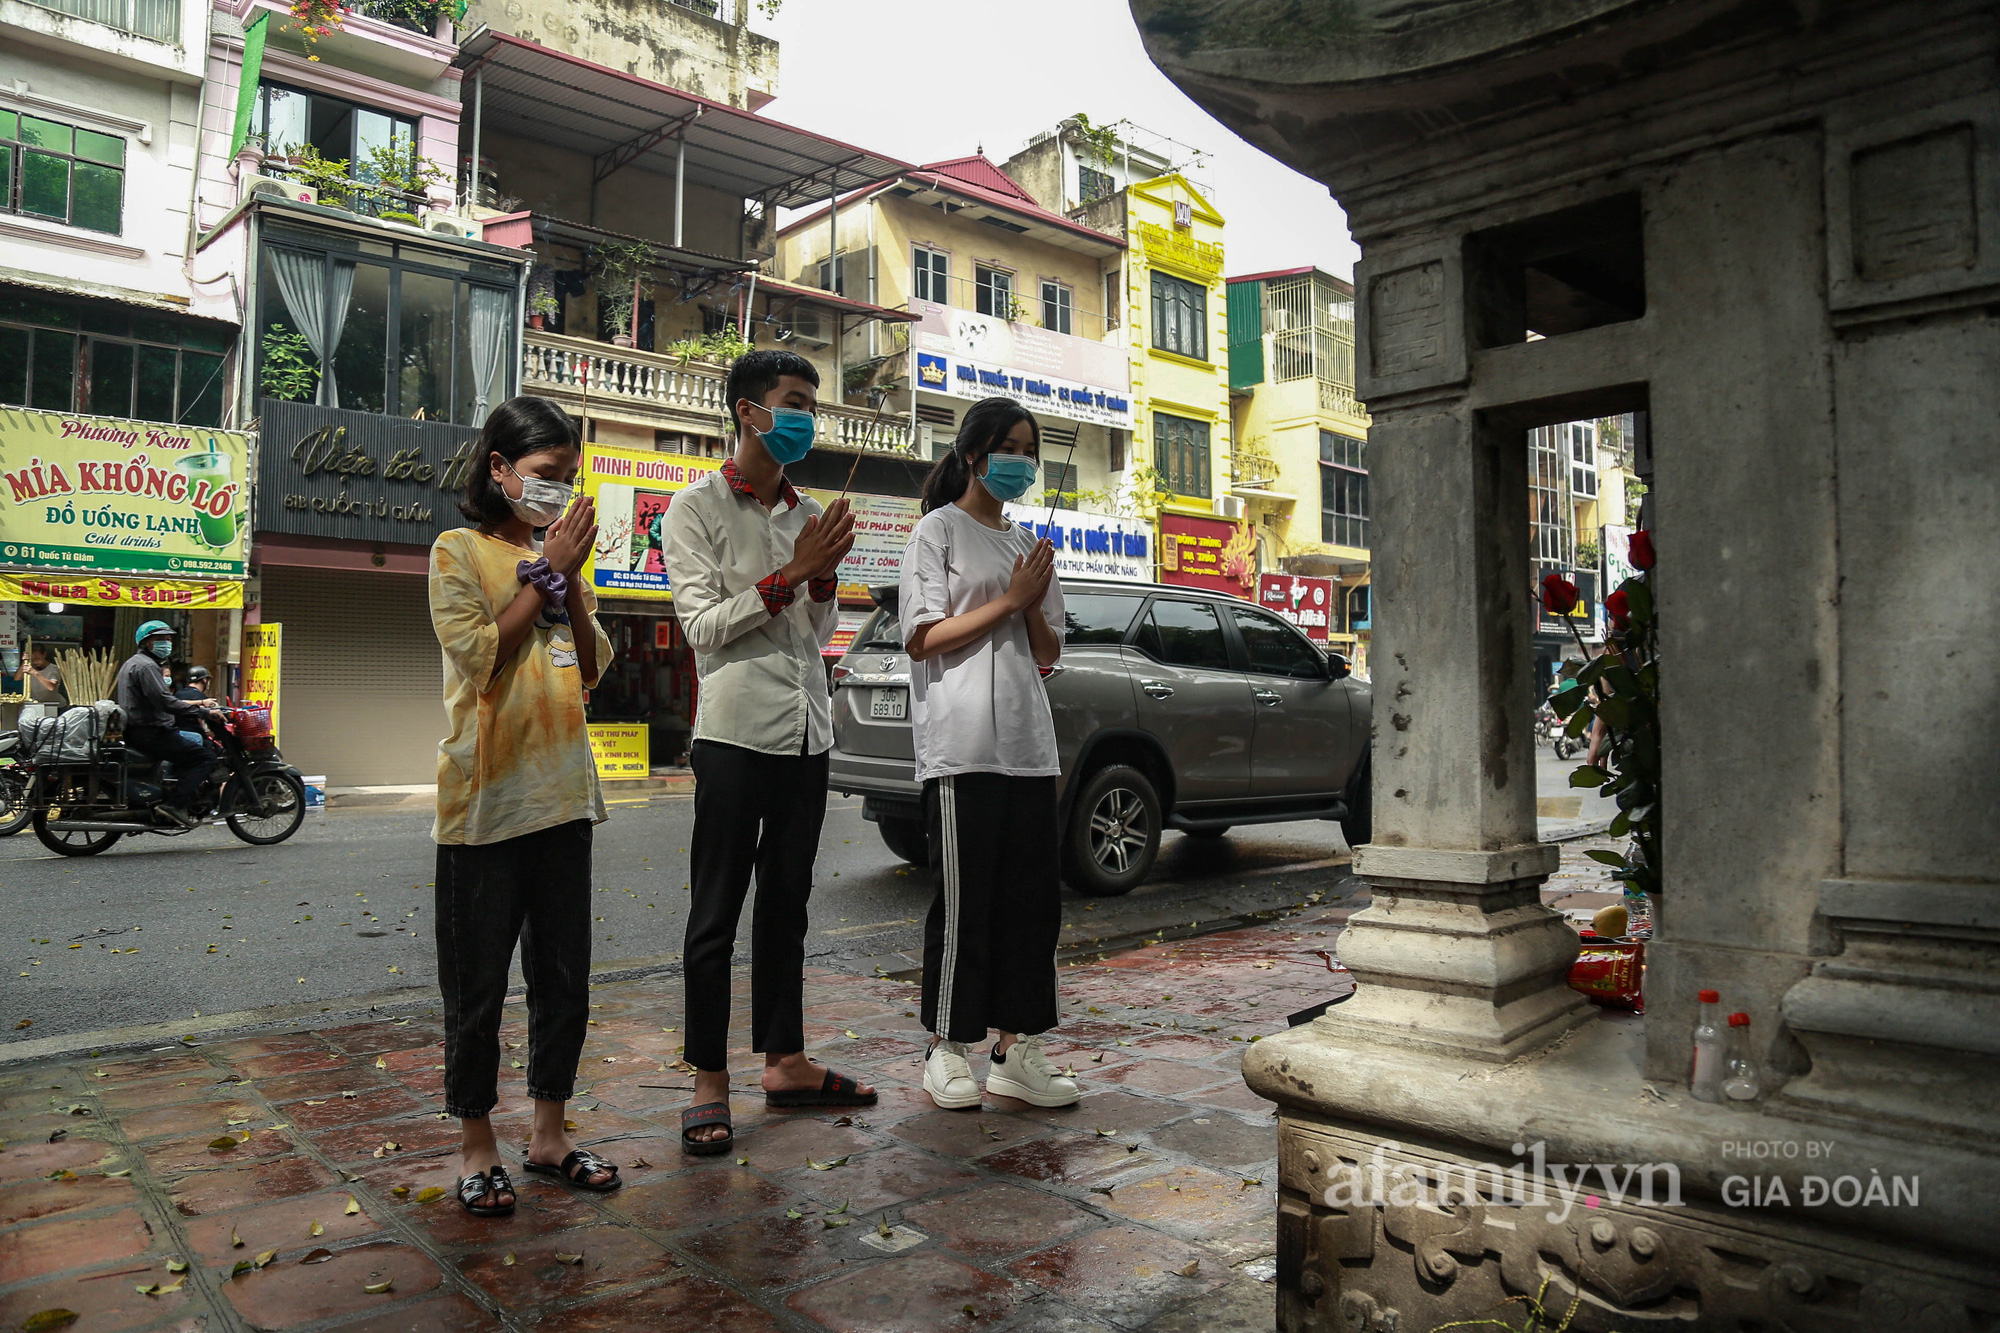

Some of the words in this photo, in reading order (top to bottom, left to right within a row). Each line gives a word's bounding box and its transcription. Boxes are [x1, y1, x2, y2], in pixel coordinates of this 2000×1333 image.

[60, 420, 139, 449] Phương
[145, 430, 191, 449] Kem
[291, 424, 376, 482] Viện
[383, 446, 435, 482] tóc
[78, 454, 187, 502] KHỔNG
[592, 455, 632, 476] MINH
[636, 459, 684, 482] ĐƯỜNG
[46, 500, 76, 525] ĐỒ
[82, 504, 140, 529] UỐNG
[146, 515, 200, 536] LẠNH
[311, 490, 361, 514] QUỐC
[365, 496, 388, 517] TỬ
[392, 501, 432, 521] GIÁM
[869, 521, 893, 532] PHÁP
[894, 522, 914, 532] CHỮ
[85, 532, 117, 545] Cold
[120, 534, 163, 549] drinks
[20, 546, 36, 560] 61
[38, 550, 60, 560] Quốc
[61, 551, 72, 561] Tử
[73, 552, 95, 562] Giám
[840, 555, 867, 567] HUẬT
[1053, 559, 1062, 570] ẨM
[21, 580, 88, 599] Mua
[98, 580, 121, 600] 3
[130, 586, 192, 605] tặng
[202, 584, 218, 602] 1
[873, 703, 902, 716] 689.10
